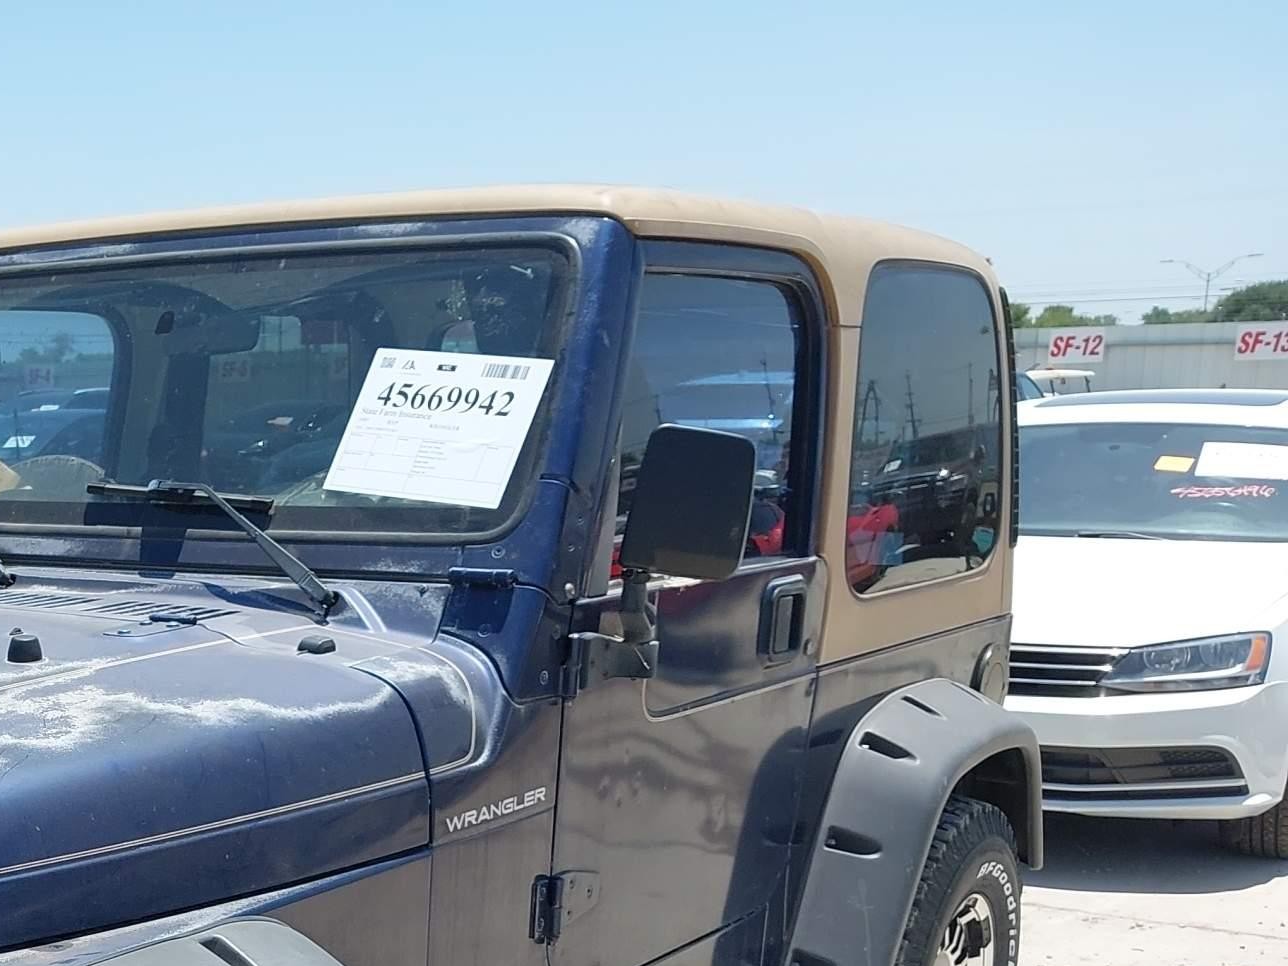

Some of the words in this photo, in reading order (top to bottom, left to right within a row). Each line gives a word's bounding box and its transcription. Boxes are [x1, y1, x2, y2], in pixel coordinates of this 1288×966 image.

[1050, 335, 1103, 357] SF-12
[377, 382, 515, 417] 45669942
[446, 787, 546, 832] WRANGLER
